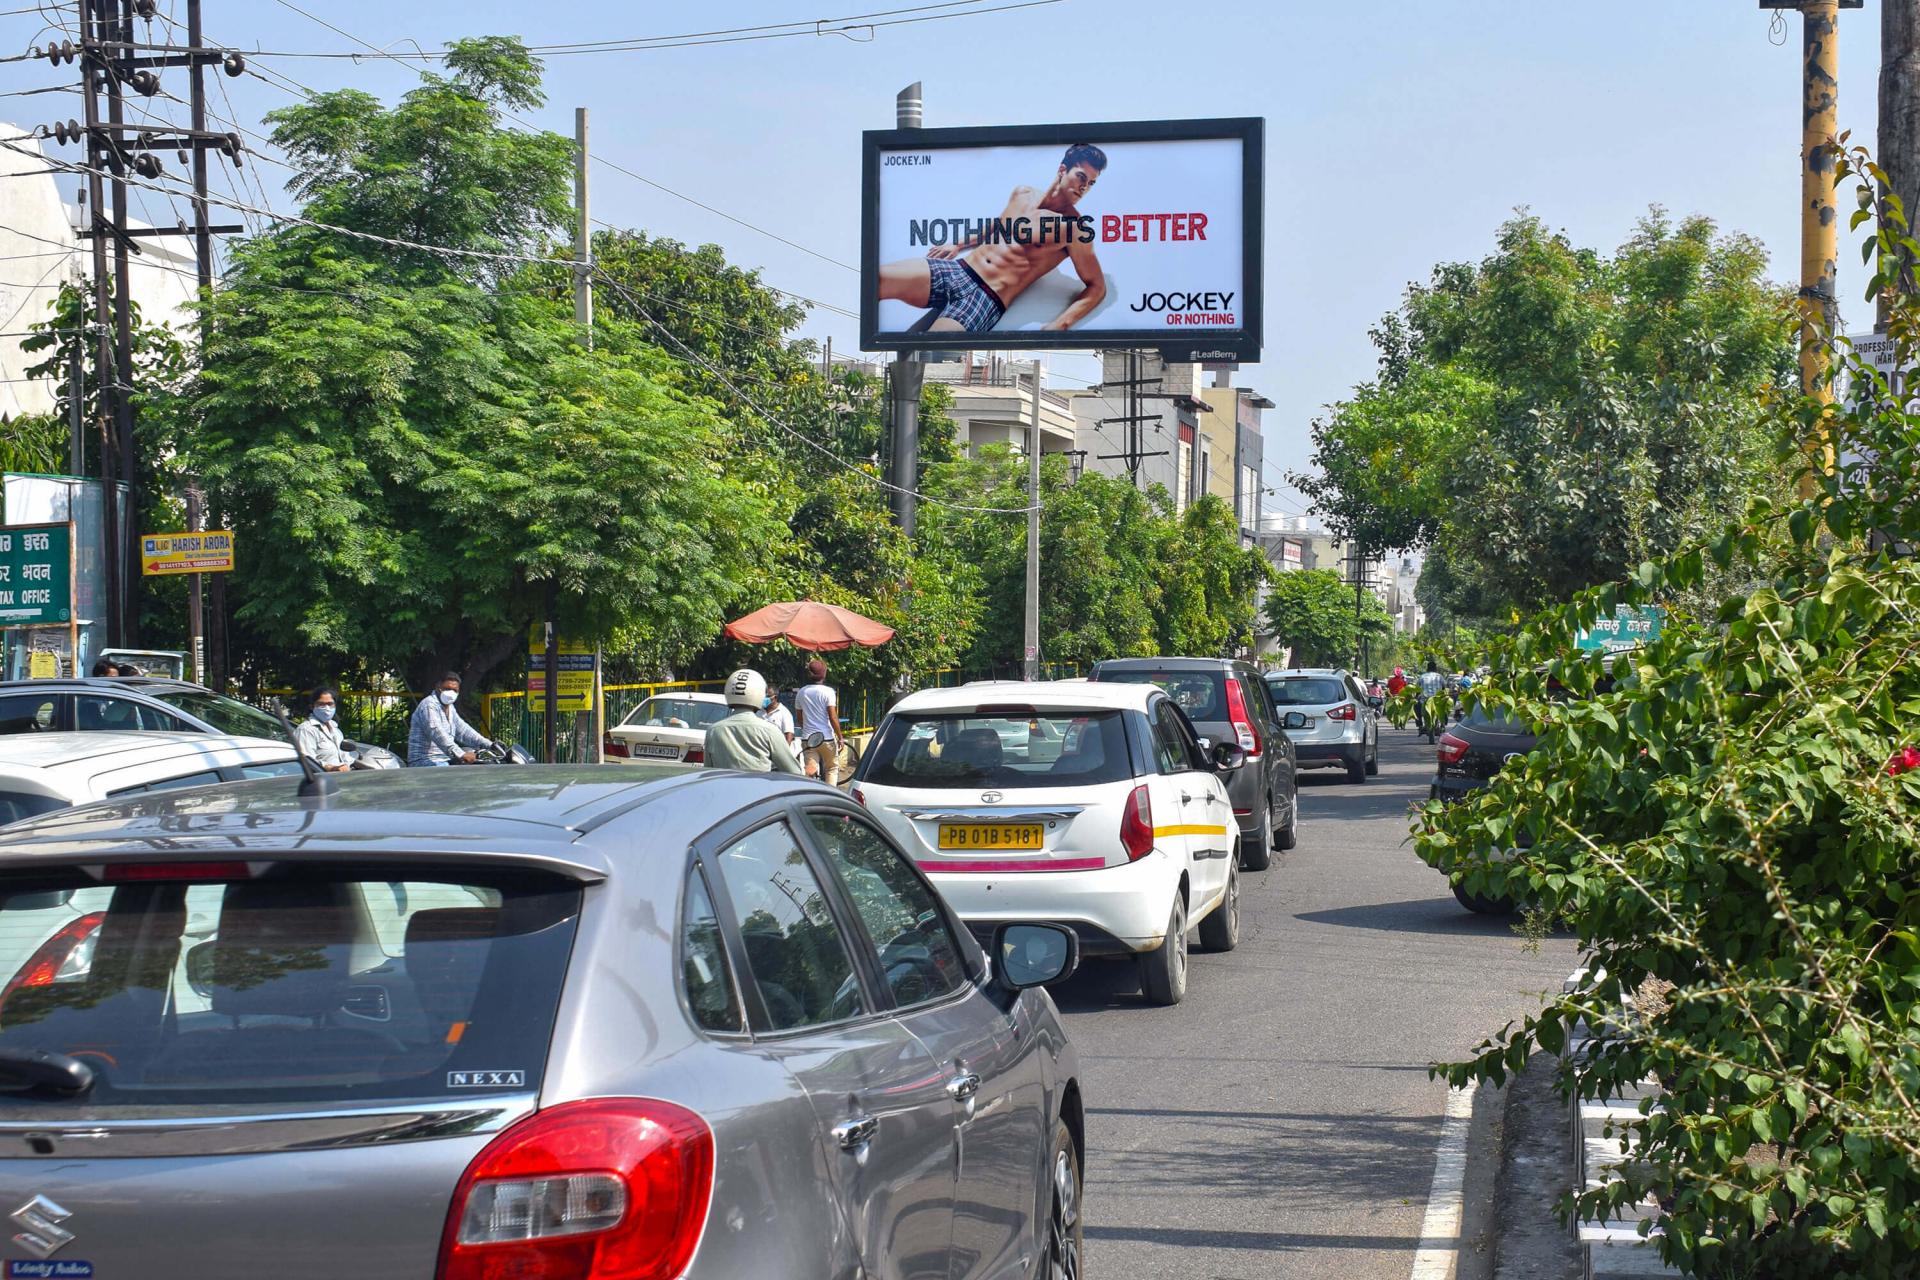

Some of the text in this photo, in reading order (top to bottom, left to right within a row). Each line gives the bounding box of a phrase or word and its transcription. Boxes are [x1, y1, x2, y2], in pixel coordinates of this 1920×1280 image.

[884, 154, 932, 166] JOCKEY.IN
[909, 213, 1209, 246] NOTHING FITS BETTER
[1130, 292, 1235, 312] JOCKEY
[1166, 312, 1235, 326] OR NOTHING
[1196, 350, 1237, 361] LeafBerry
[172, 537, 201, 552] HARISH
[203, 535, 230, 551] ARORA
[22, 563, 52, 581] भवन
[21, 588, 51, 604] OFFICE
[949, 828, 1040, 845] PB 01B 5181
[453, 1072, 521, 1086] NEXA
